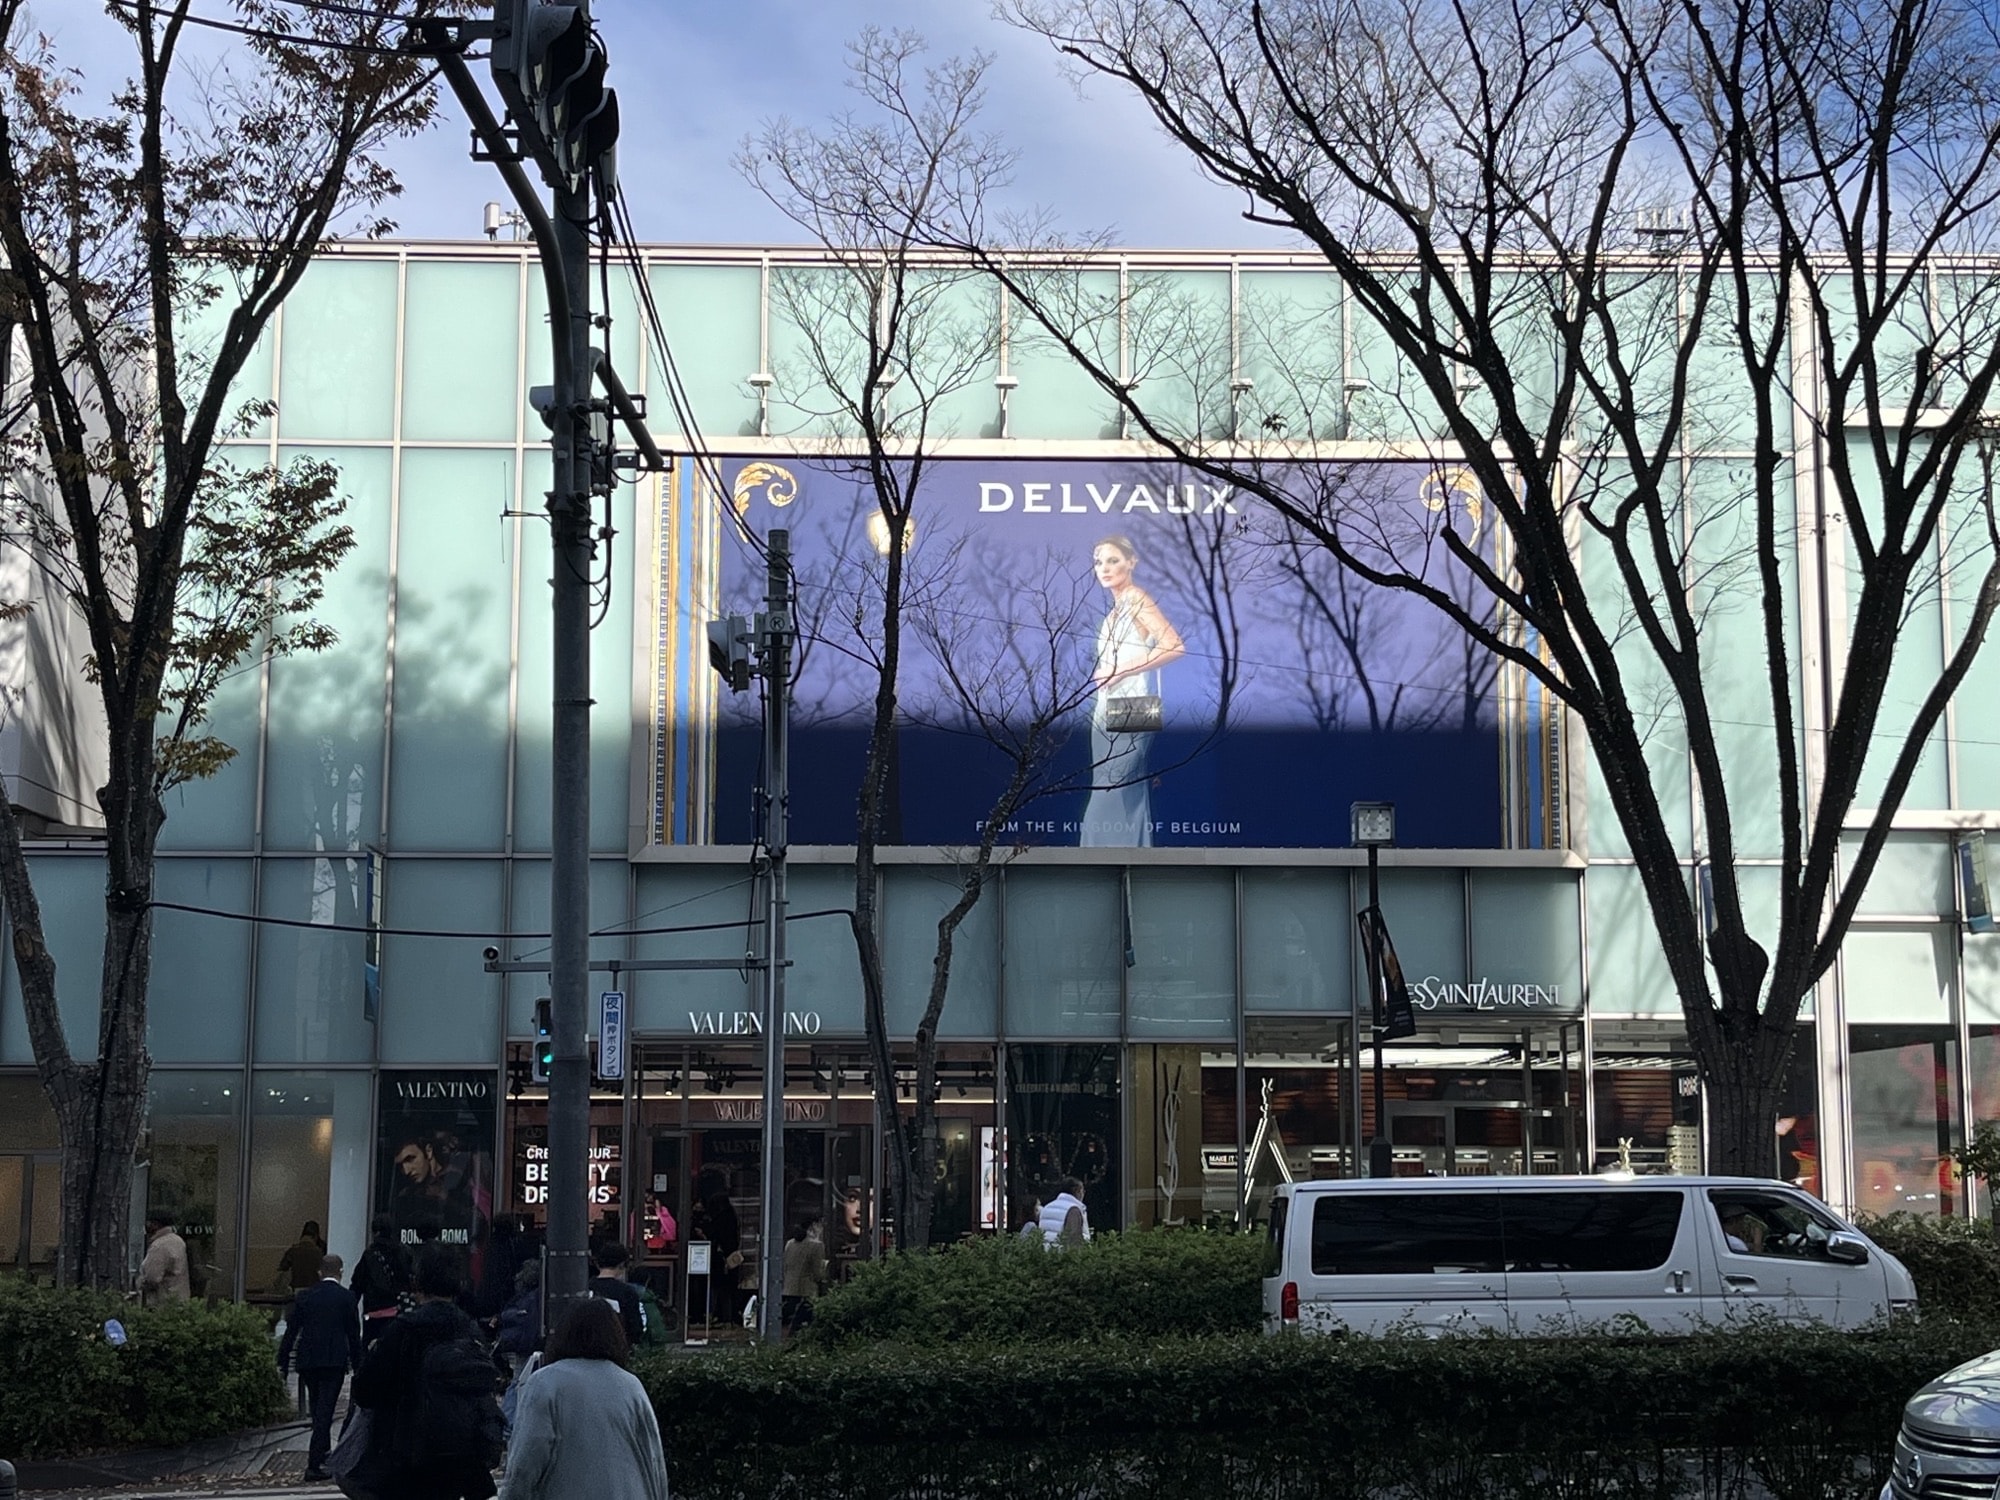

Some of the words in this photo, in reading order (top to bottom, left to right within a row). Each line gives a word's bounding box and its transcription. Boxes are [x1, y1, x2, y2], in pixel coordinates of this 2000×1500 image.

[978, 482, 1238, 514] DELVAUX
[1025, 821, 1055, 833] THE
[1063, 821, 1136, 833] KINGDOM
[1144, 821, 1164, 833] OF
[1171, 821, 1241, 834] BELGIUM
[688, 1011, 821, 1035] VALENINO
[396, 1081, 486, 1098] VALENTINO
[713, 1100, 825, 1122] VALEINO
[526, 1147, 549, 1160] CRE
[526, 1163, 610, 1182] BETY
[525, 1186, 610, 1204] DRMS
[441, 1228, 469, 1244] ROMA
